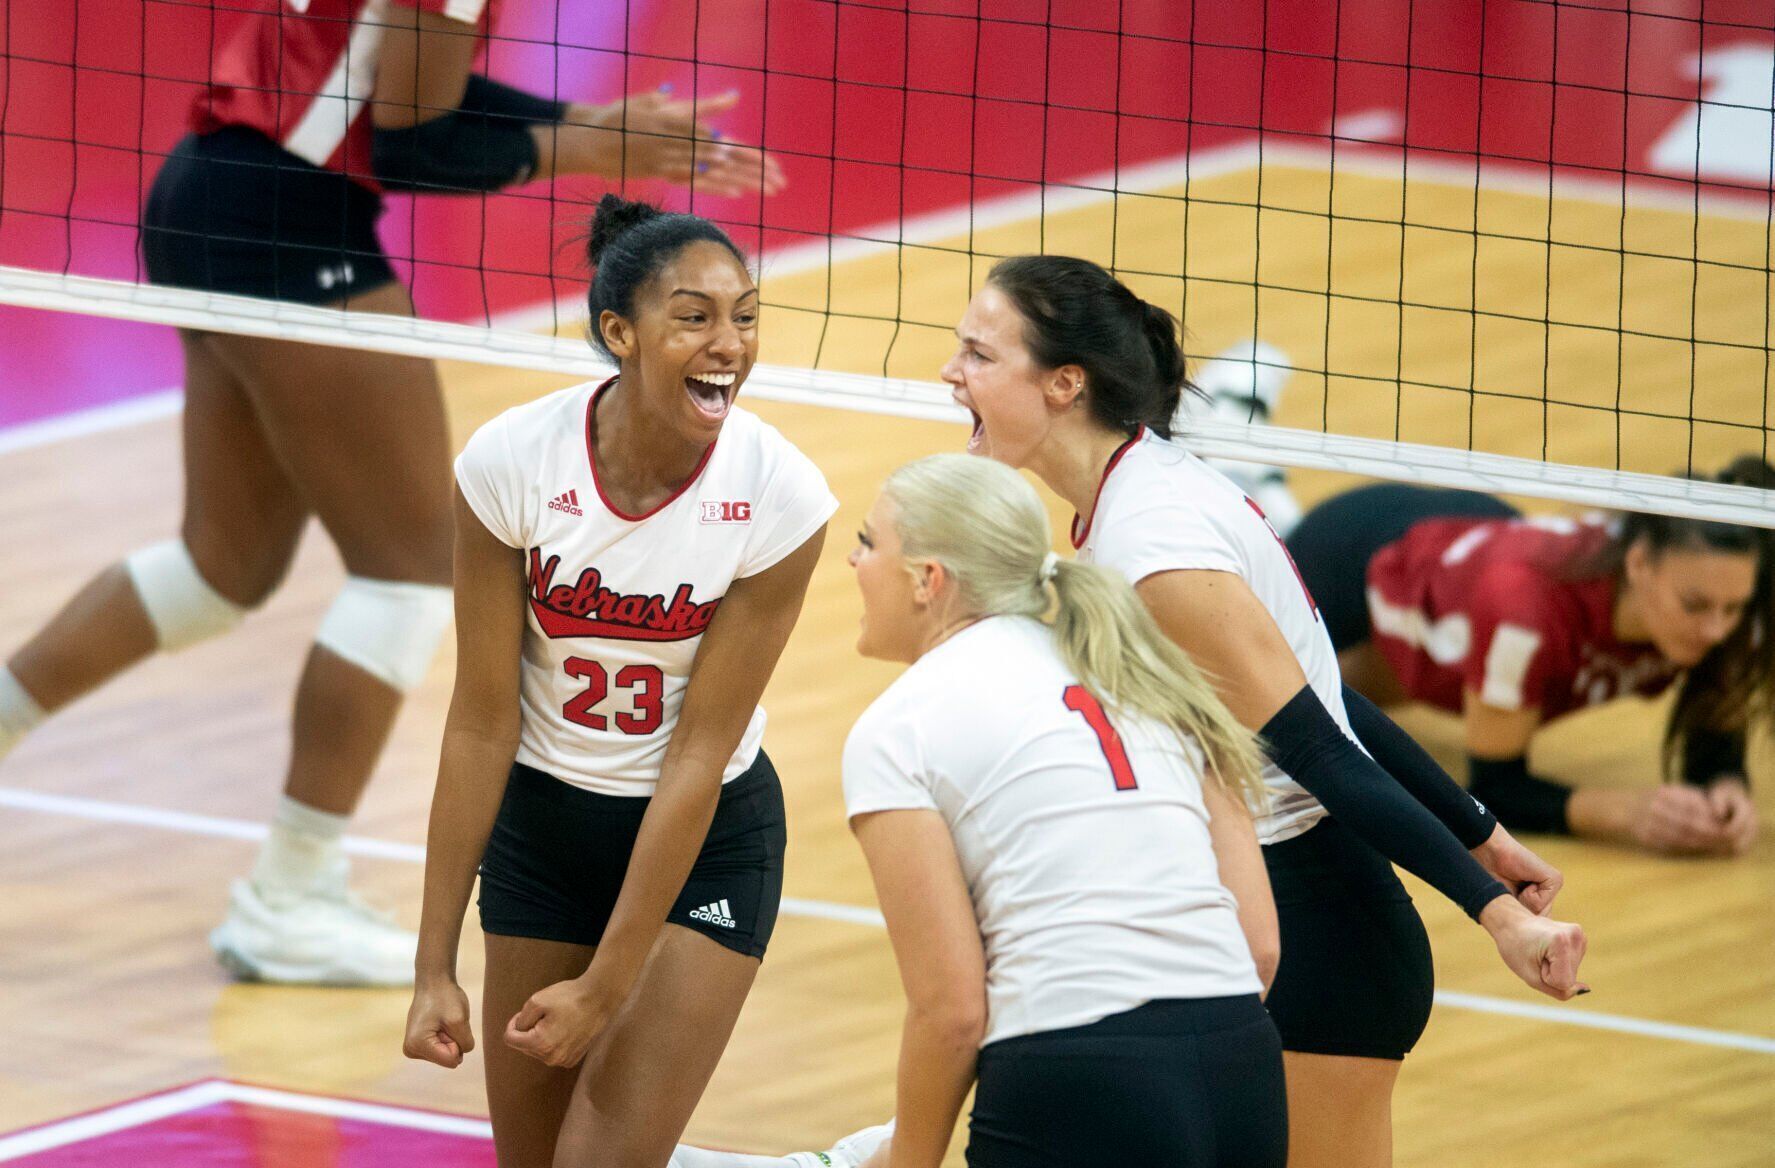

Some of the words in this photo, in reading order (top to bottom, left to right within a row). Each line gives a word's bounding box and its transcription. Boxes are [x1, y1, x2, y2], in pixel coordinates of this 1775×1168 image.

[547, 500, 584, 517] adidas
[529, 546, 723, 633] Nebraska
[562, 655, 664, 735] 23
[1062, 684, 1139, 791] 1
[689, 909, 736, 928] adidas
